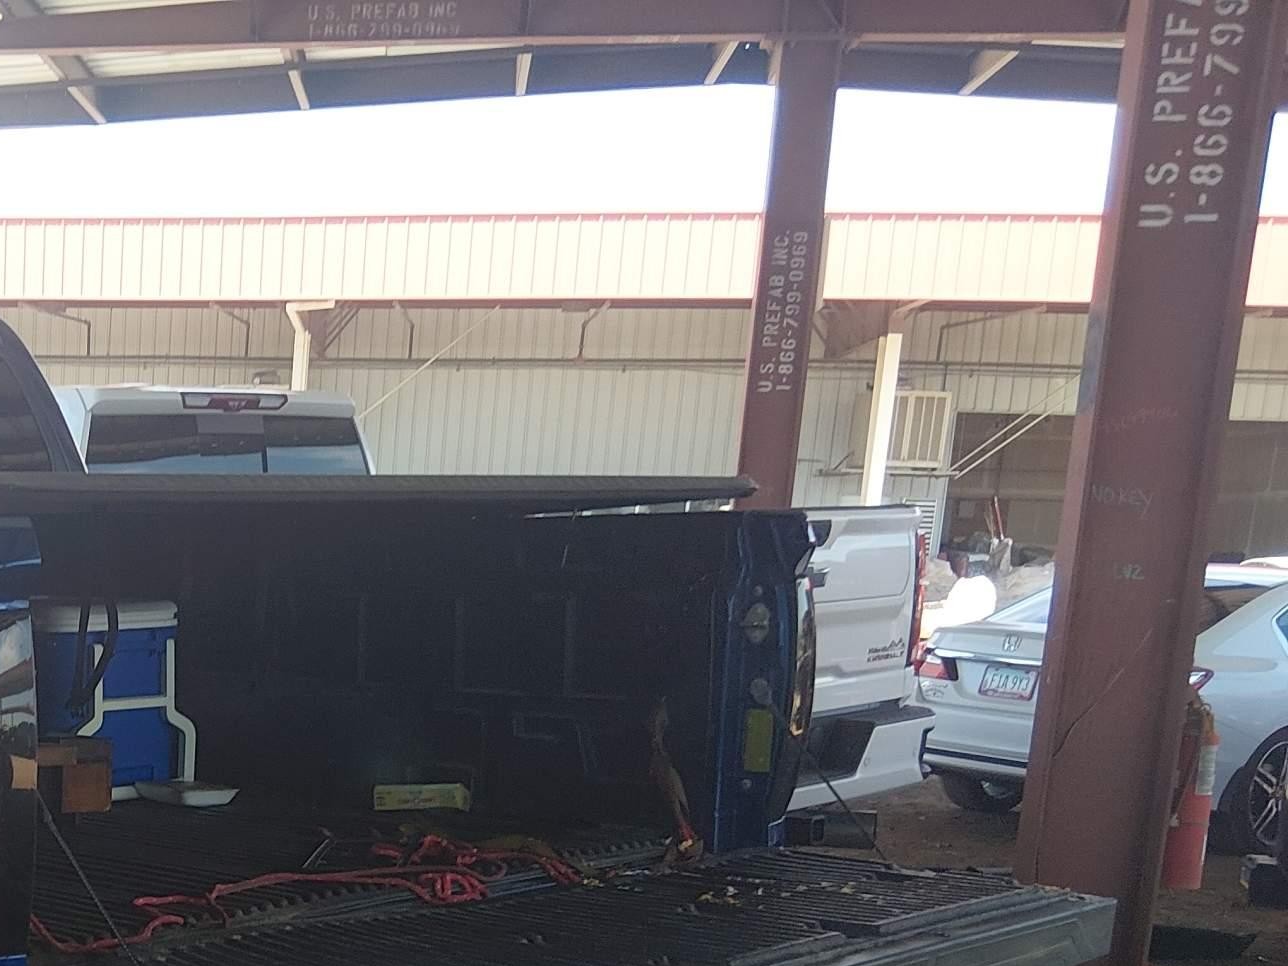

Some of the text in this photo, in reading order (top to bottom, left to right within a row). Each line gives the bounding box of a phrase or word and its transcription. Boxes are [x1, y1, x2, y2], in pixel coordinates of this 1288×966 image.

[1137, 0, 1203, 228] U.S. PREF
[762, 274, 785, 348] PREFAB
[775, 231, 808, 391] 1-866-799-0969
[756, 356, 776, 393] U.S.
